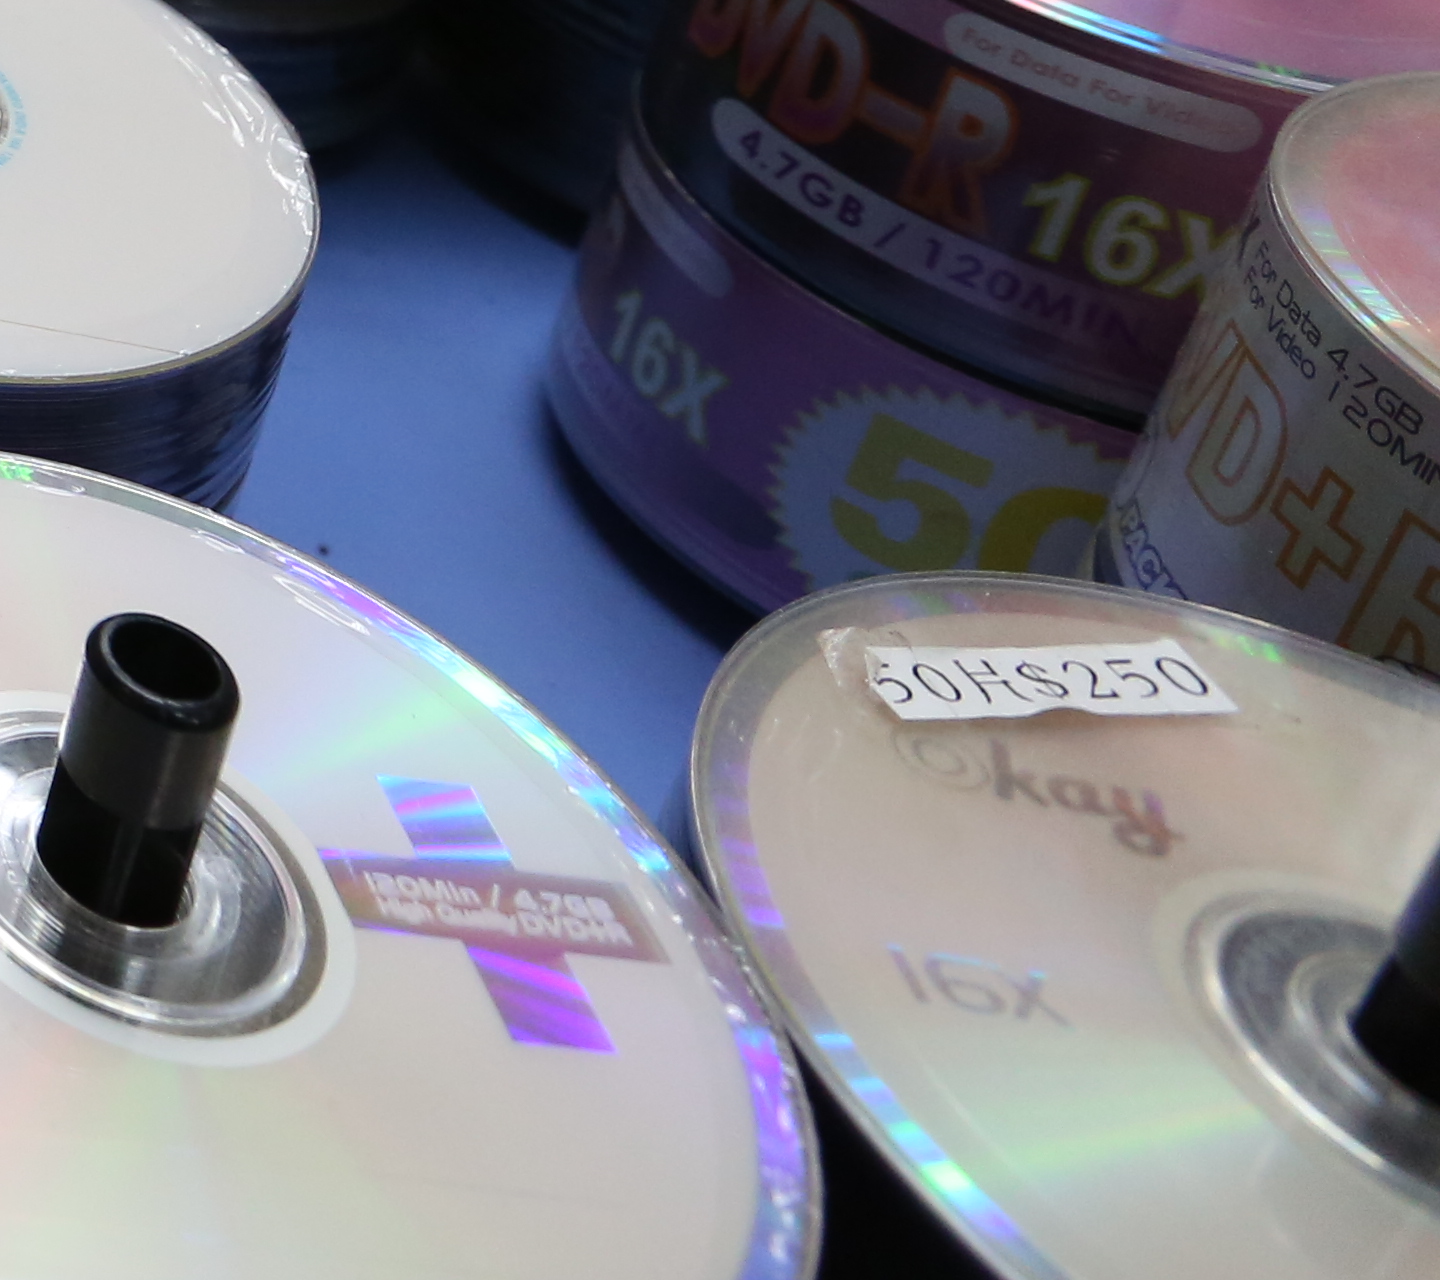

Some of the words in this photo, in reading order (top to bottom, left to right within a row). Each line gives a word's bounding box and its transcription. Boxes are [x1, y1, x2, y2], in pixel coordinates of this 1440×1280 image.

[739, 130, 864, 230] 4.7GB
[1021, 171, 1225, 305] 16X
[608, 289, 731, 450] 16X
[1264, 301, 1317, 382] Video
[1274, 278, 1323, 349] Data
[1326, 344, 1426, 437] 4.7GB
[887, 942, 1076, 1030] 16X
